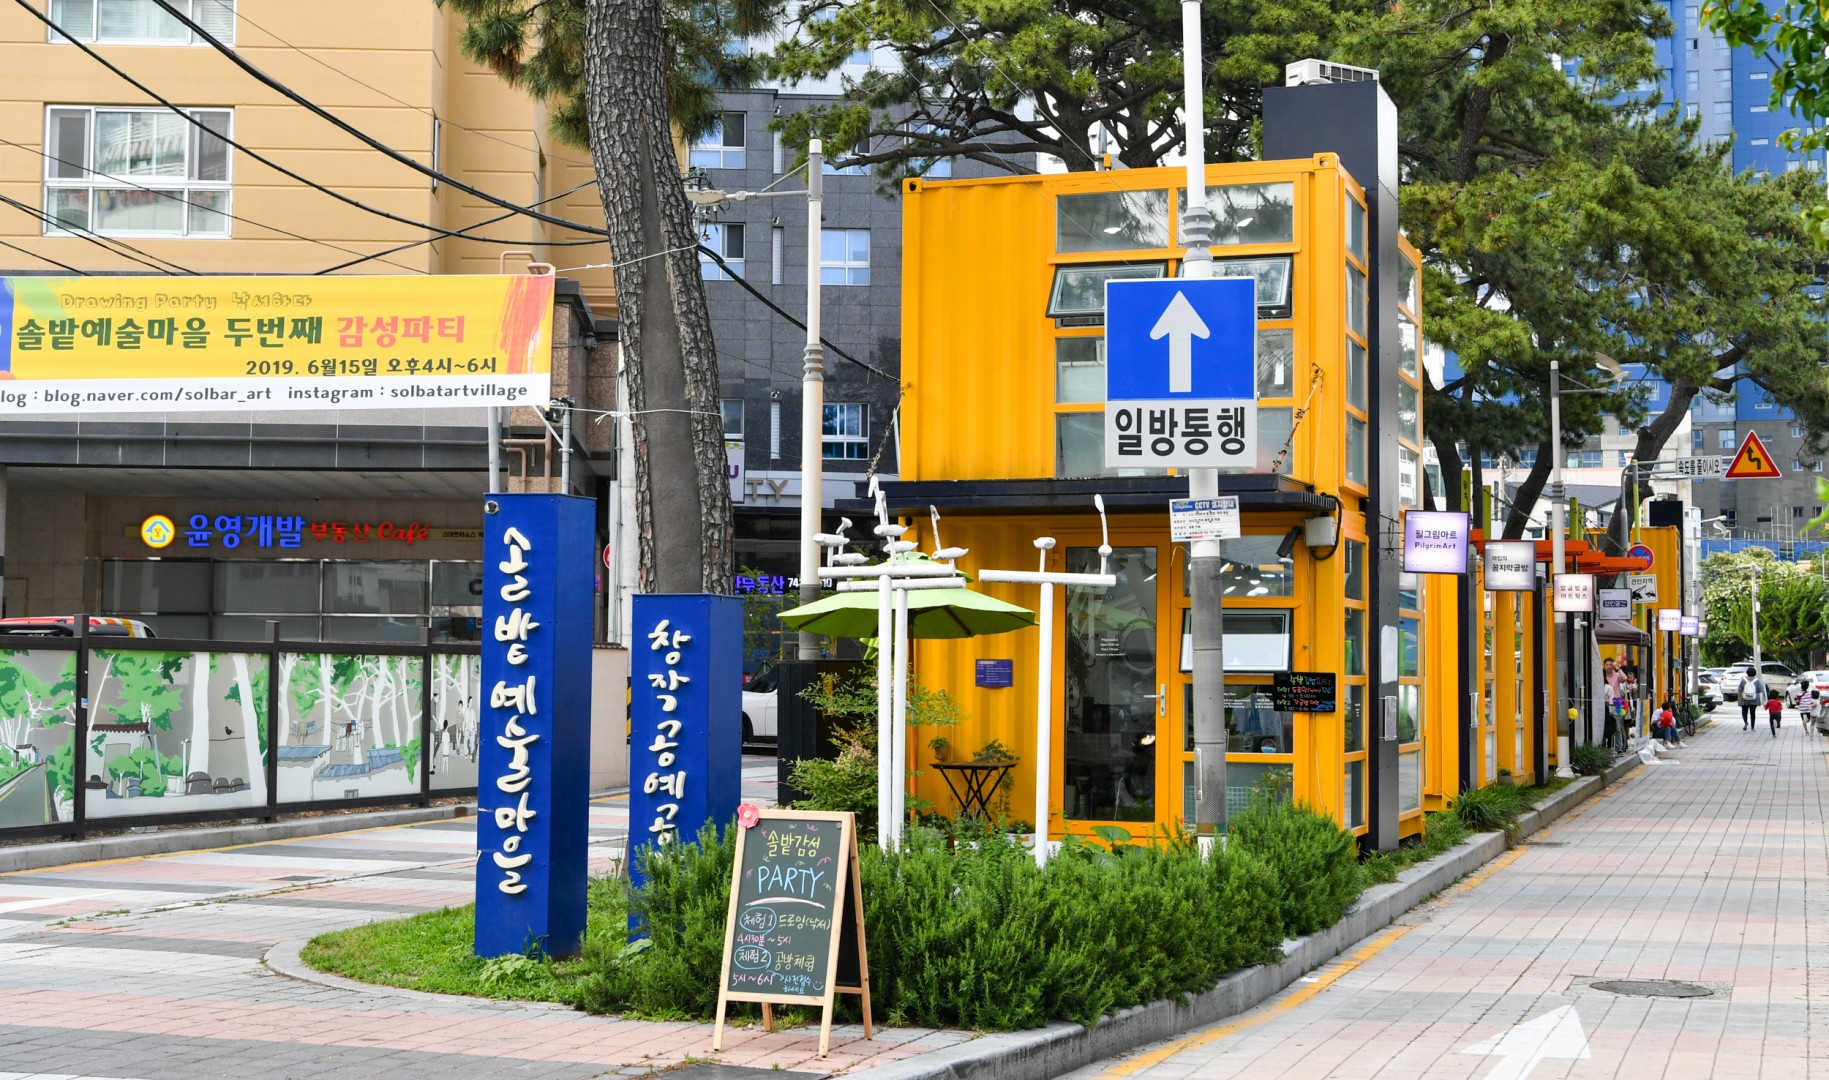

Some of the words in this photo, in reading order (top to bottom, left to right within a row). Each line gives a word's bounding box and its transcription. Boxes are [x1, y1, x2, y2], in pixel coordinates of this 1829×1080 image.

[61, 294, 147, 311] Drawing
[155, 294, 217, 311] Party
[232, 291, 312, 310] 낙서하다
[16, 317, 210, 350] 솔밭예술마을
[224, 316, 322, 348] 두번째
[337, 315, 465, 348] 감성파티
[246, 360, 299, 375] 2019.
[308, 358, 377, 376] 6월15일
[386, 357, 496, 375] 오후4시~6시
[44, 387, 271, 407] blog.naver.com/solbar_art
[289, 386, 373, 404] instagram
[391, 384, 528, 401] solbatartvillage
[1115, 406, 1245, 456] 일방통행
[184, 514, 306, 549] 윤영개발
[309, 522, 370, 543] 부동산
[1415, 529, 1457, 540] 필그림아트
[1415, 542, 1456, 550] PilgrimArt
[1631, 577, 1653, 585] 견인지역
[491, 527, 540, 895] 솔밭예술마을
[644, 619, 691, 860] 창작공예공
[767, 830, 821, 857] 솔밭감성
[758, 864, 824, 898] PARTY
[778, 914, 831, 930] 드로잉(낙서)
